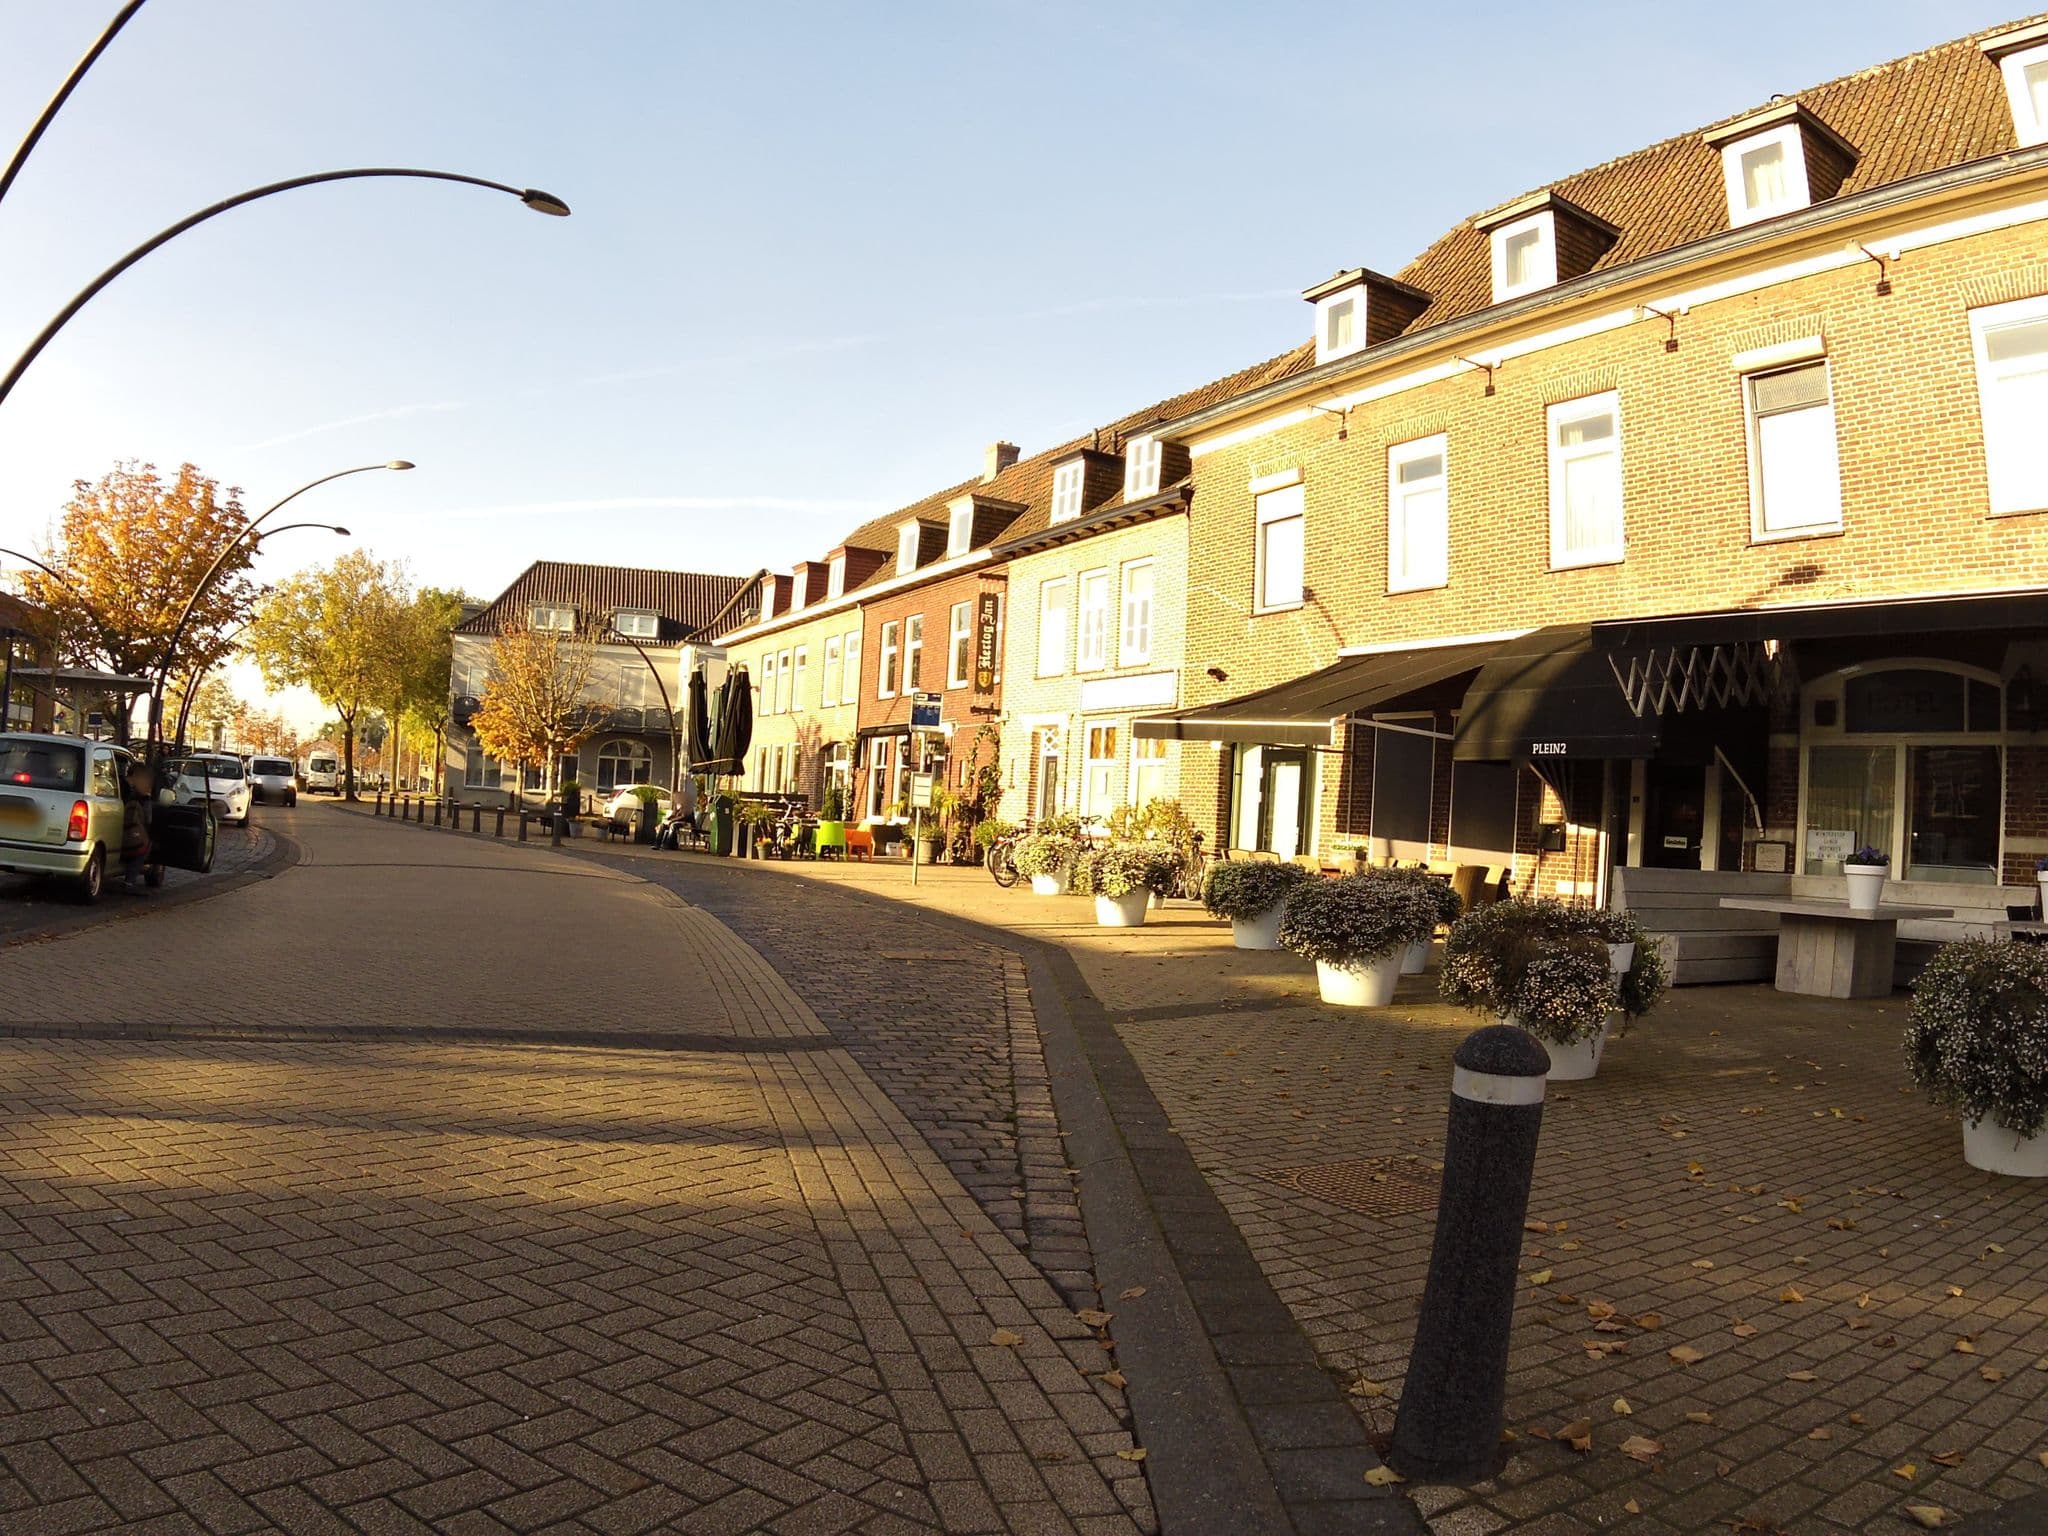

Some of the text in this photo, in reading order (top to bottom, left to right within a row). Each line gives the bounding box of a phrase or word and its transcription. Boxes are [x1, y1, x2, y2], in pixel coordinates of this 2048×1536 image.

[977, 600, 996, 669] Hertog Jan
[1532, 743, 1567, 754] PLEIN2
